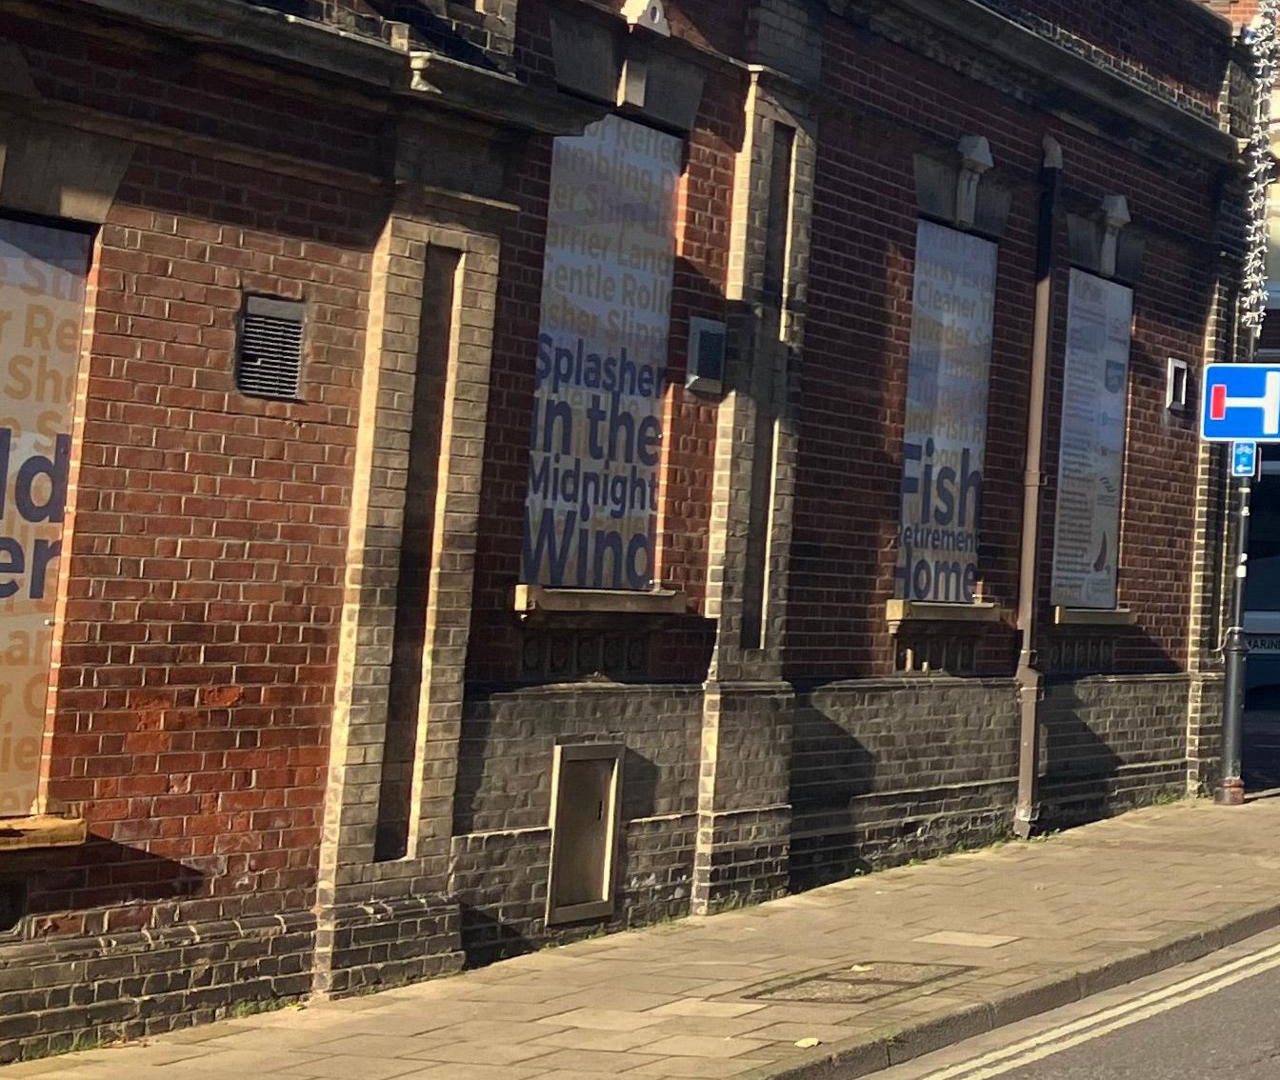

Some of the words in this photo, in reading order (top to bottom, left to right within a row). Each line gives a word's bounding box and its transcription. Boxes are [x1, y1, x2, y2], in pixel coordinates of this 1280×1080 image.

[537, 333, 668, 398] Splasher
[586, 391, 662, 467] the
[529, 453, 659, 520] Midnight
[900, 436, 985, 528] Fish
[523, 506, 657, 588] Wind
